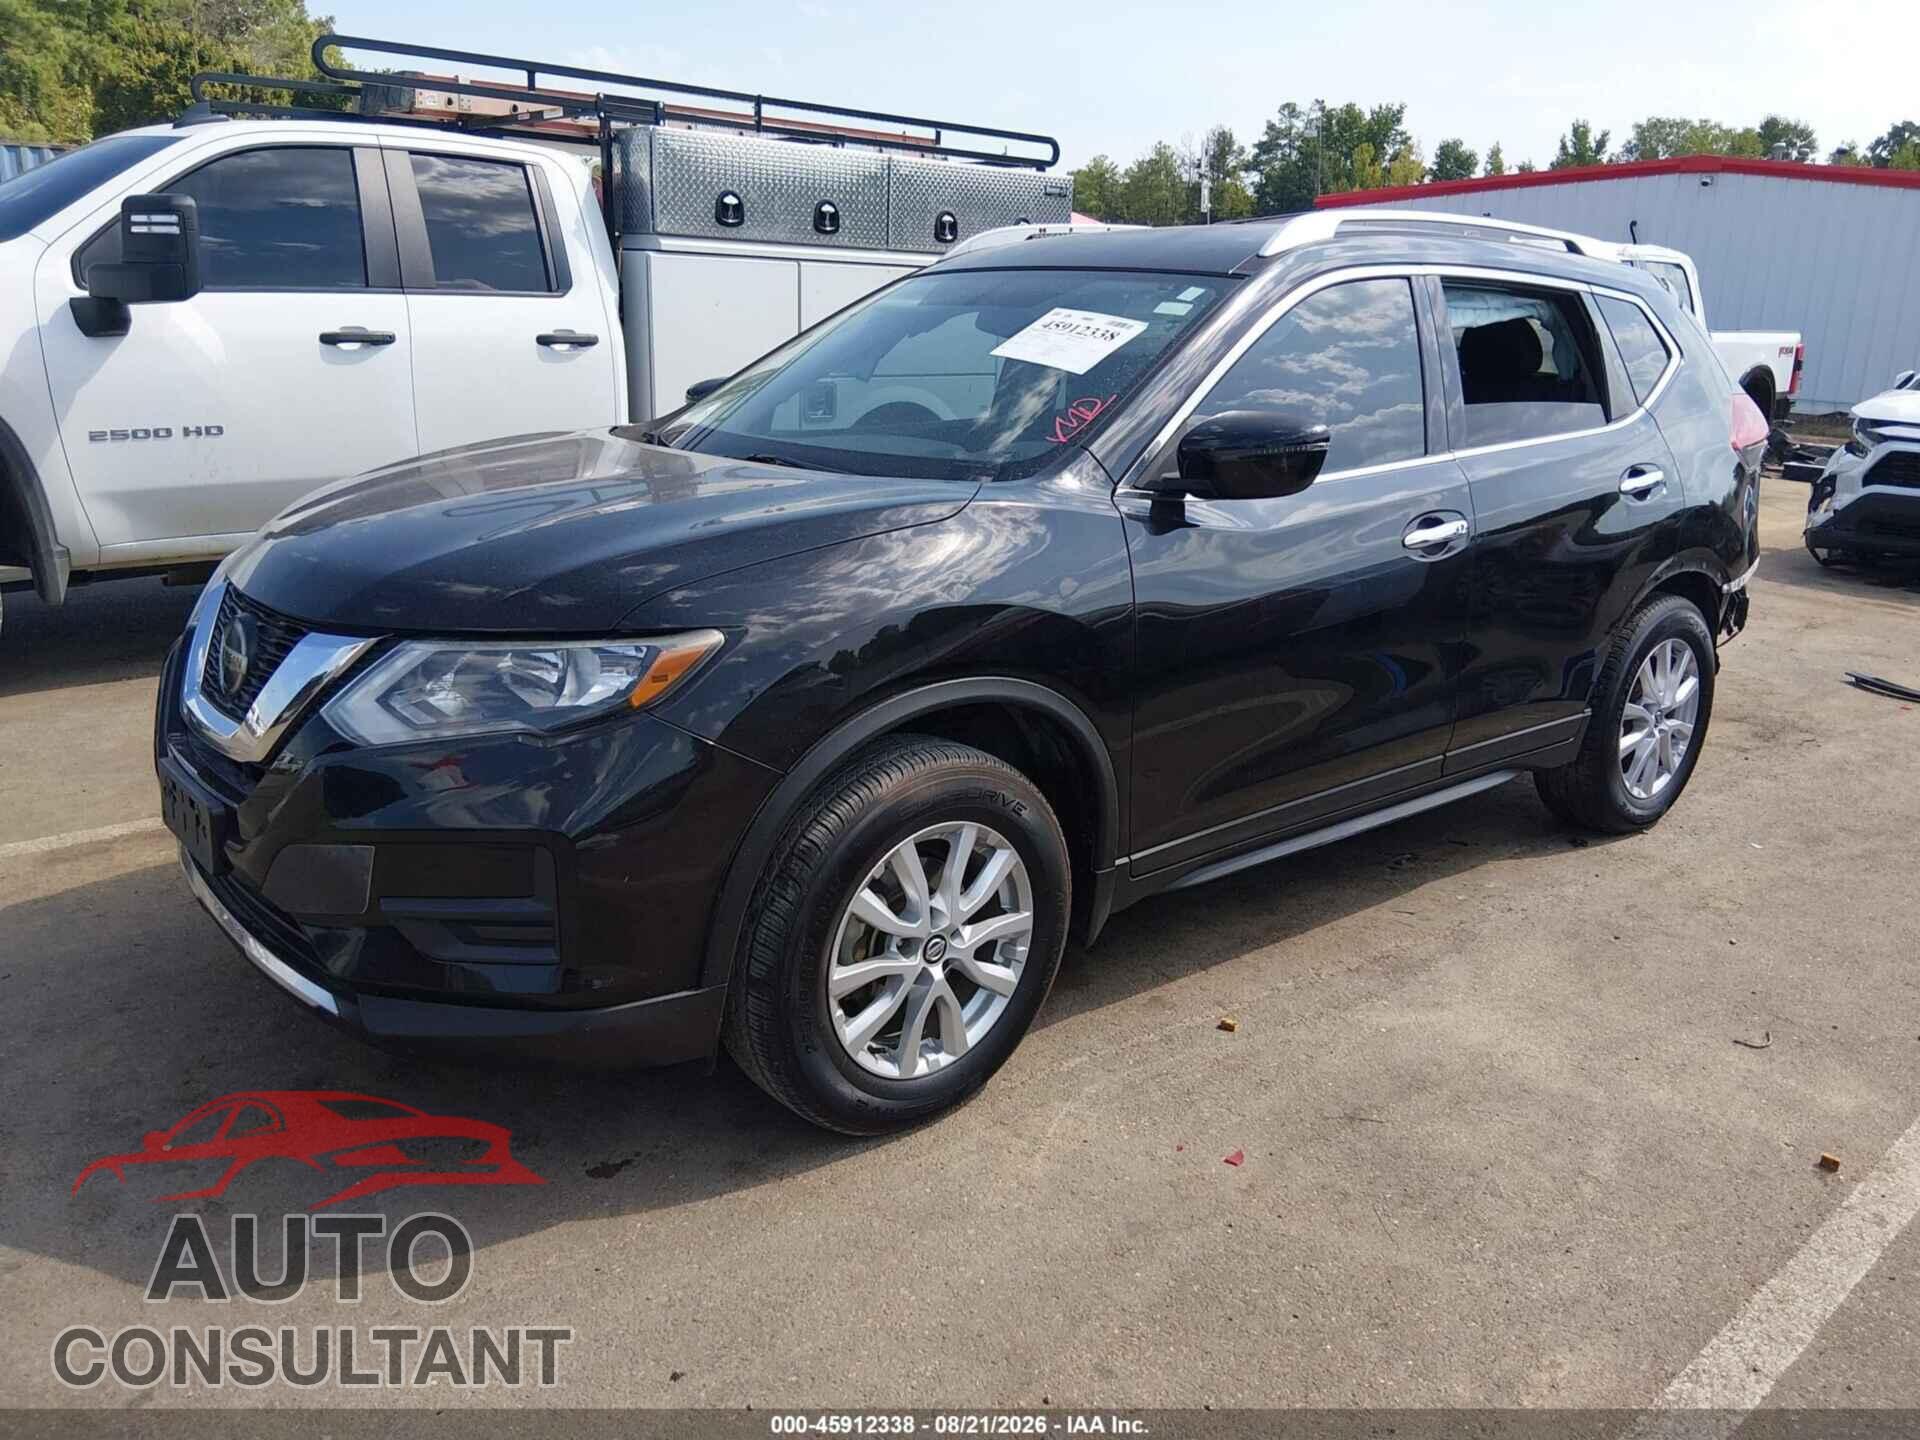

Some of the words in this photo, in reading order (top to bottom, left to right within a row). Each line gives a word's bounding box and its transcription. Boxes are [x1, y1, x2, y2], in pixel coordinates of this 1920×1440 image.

[1042, 320, 1121, 343] 45912338
[88, 427, 173, 441] 2500
[183, 425, 224, 437] HD
